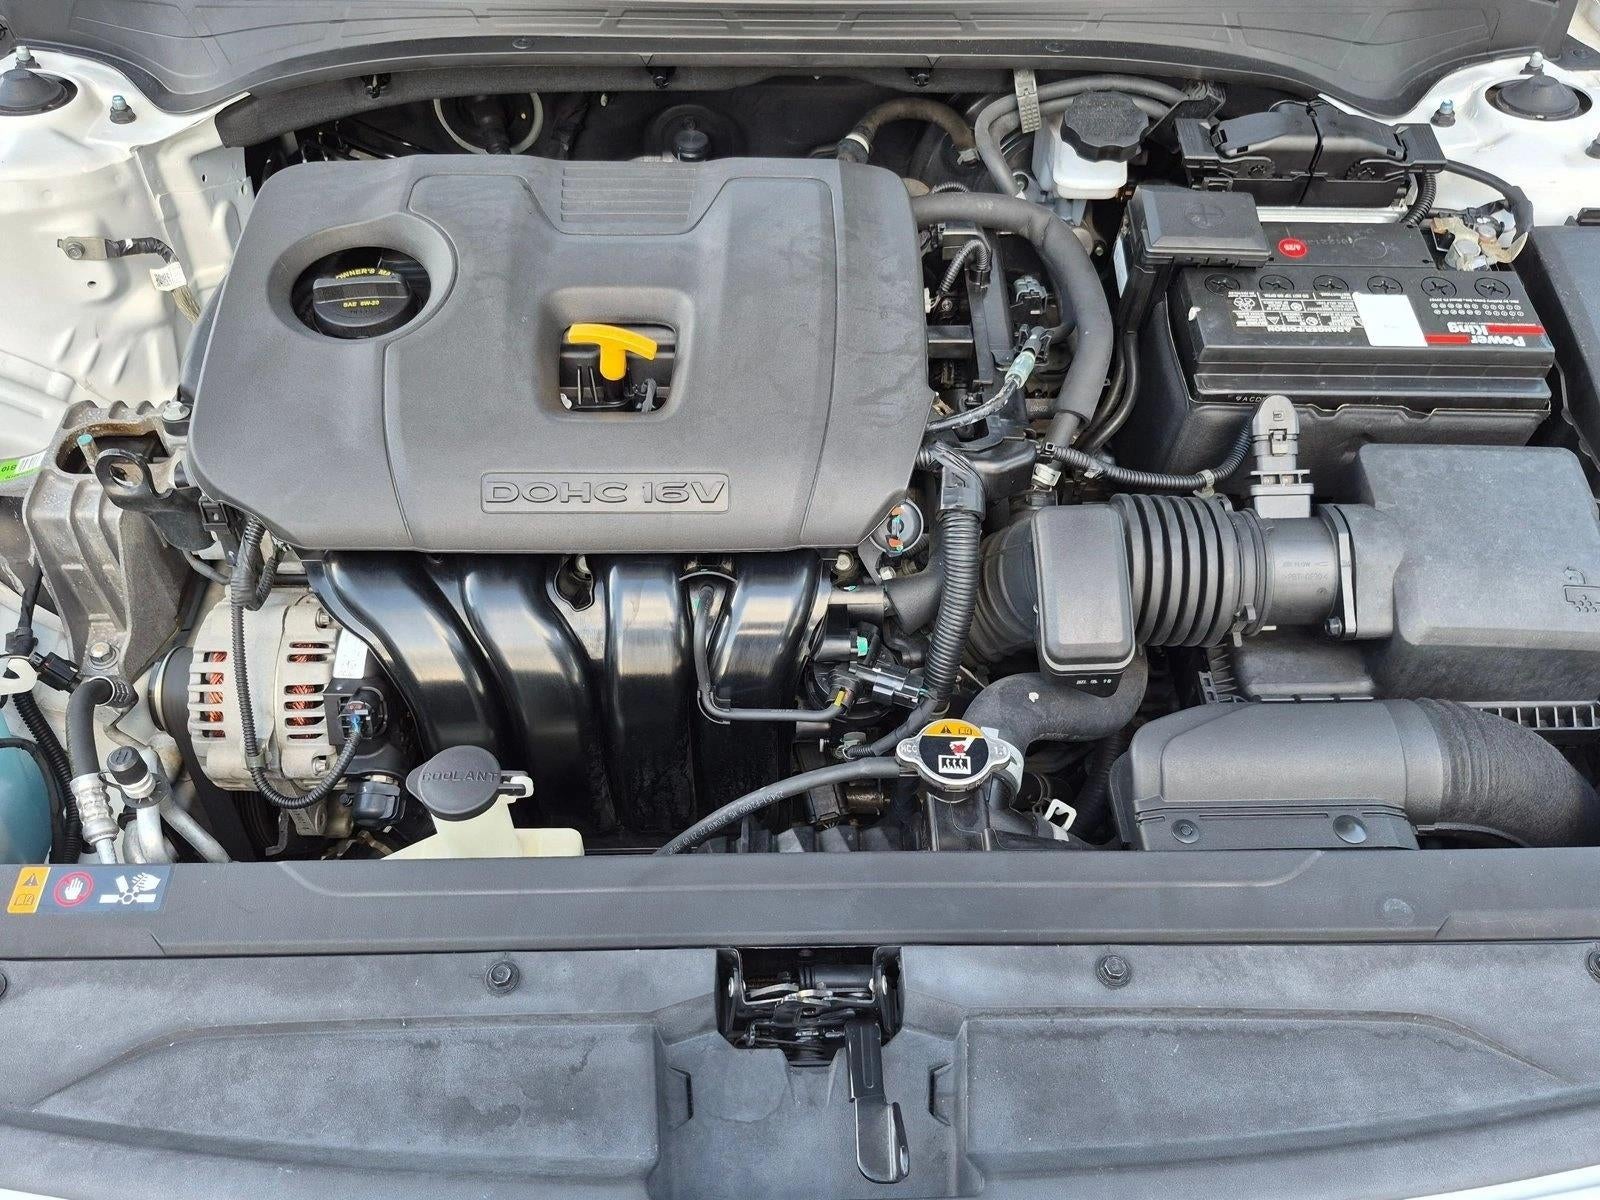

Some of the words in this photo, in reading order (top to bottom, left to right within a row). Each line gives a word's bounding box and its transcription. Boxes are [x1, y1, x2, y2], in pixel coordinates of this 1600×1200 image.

[1447, 321, 1489, 336] King
[1471, 335, 1526, 347] Power
[485, 480, 628, 504] DOHC
[642, 480, 726, 504] 16V
[422, 769, 499, 783] COOLANT
